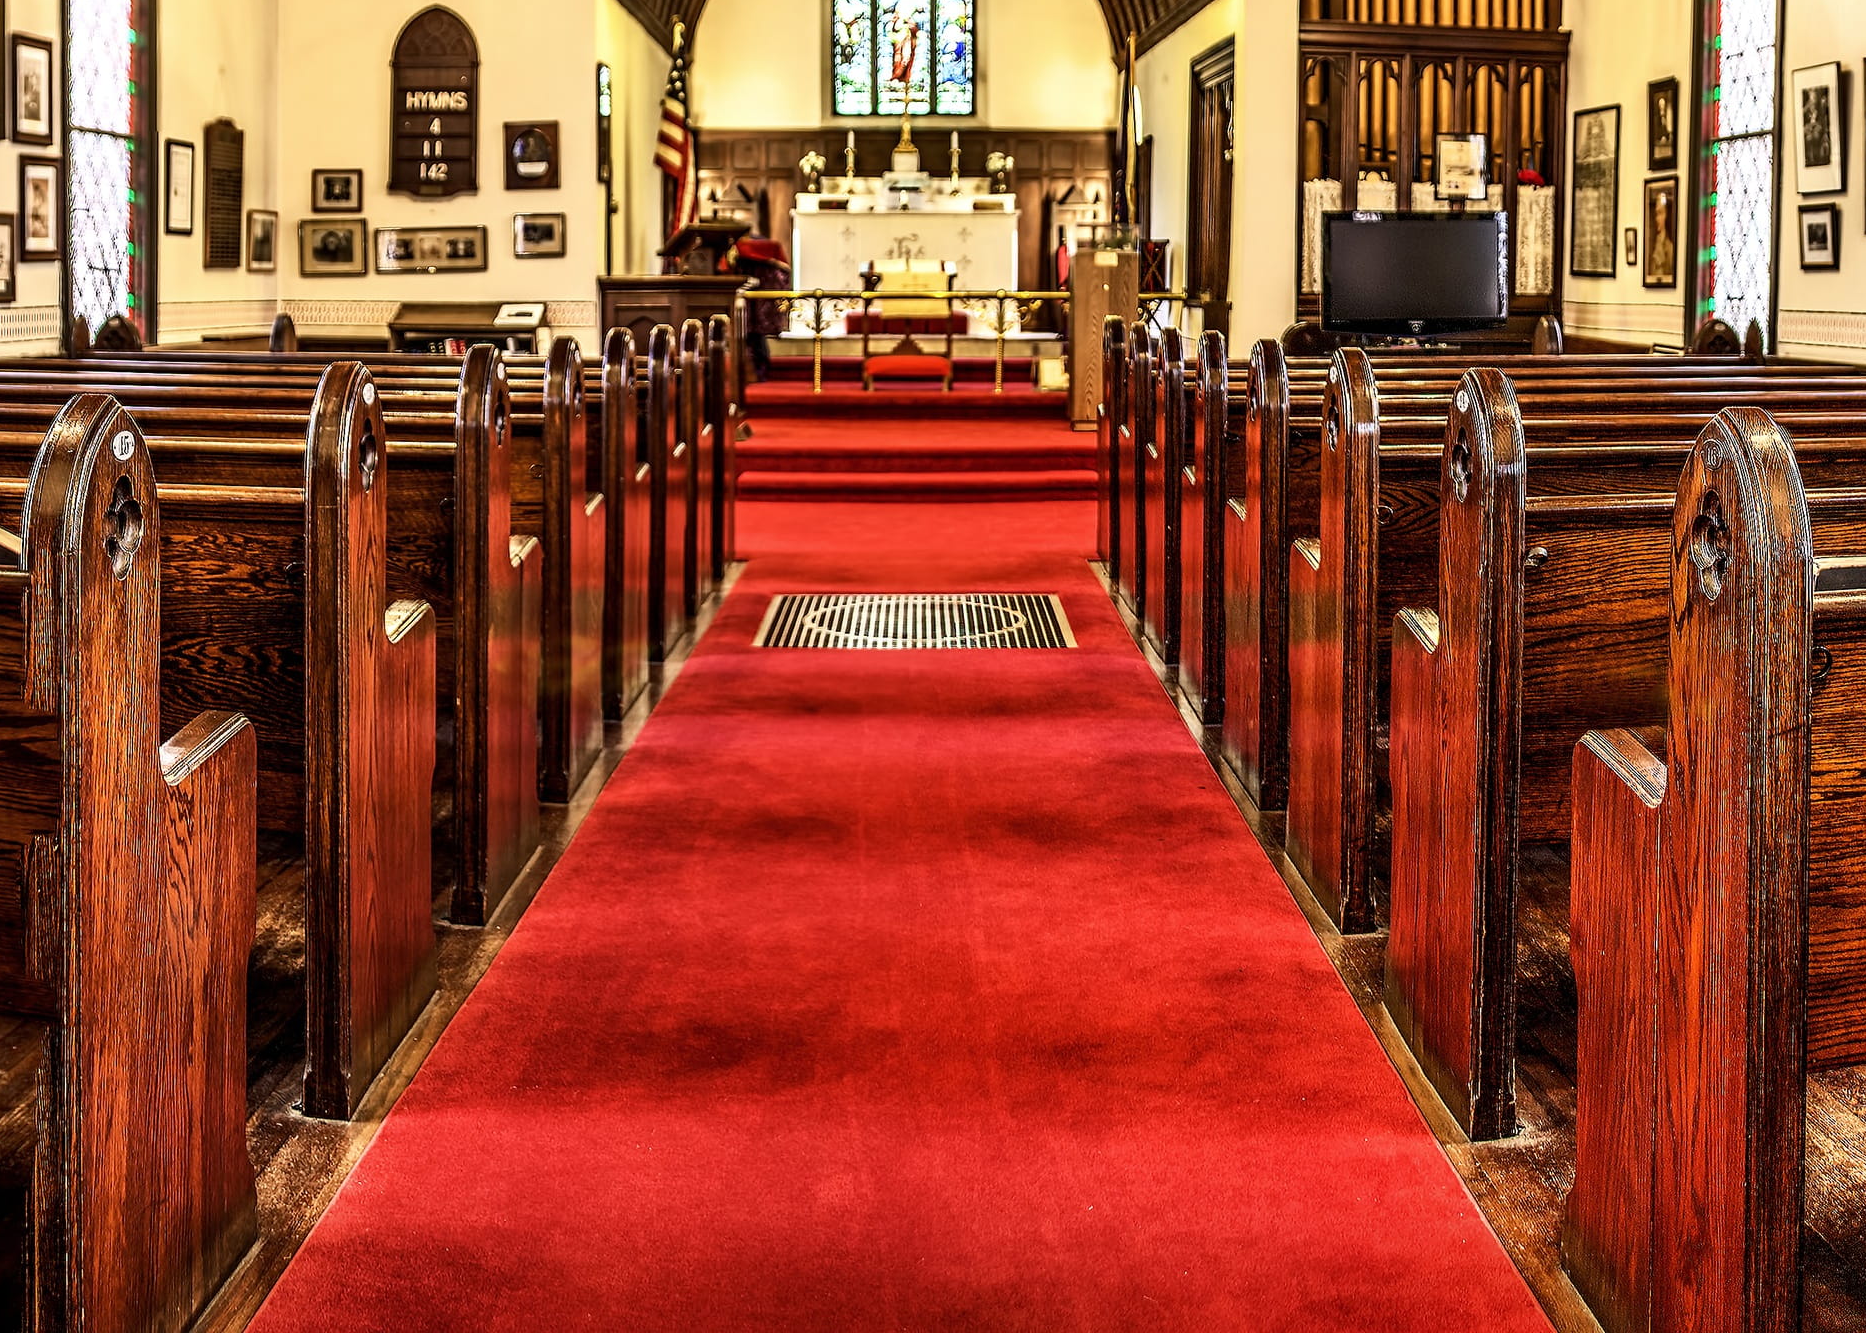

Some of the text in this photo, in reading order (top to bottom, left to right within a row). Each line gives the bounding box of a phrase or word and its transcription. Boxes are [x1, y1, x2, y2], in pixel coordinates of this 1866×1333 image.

[406, 91, 468, 111] HYMNS
[429, 117, 441, 135] 4
[423, 140, 442, 157] 11
[420, 162, 448, 181] 142
